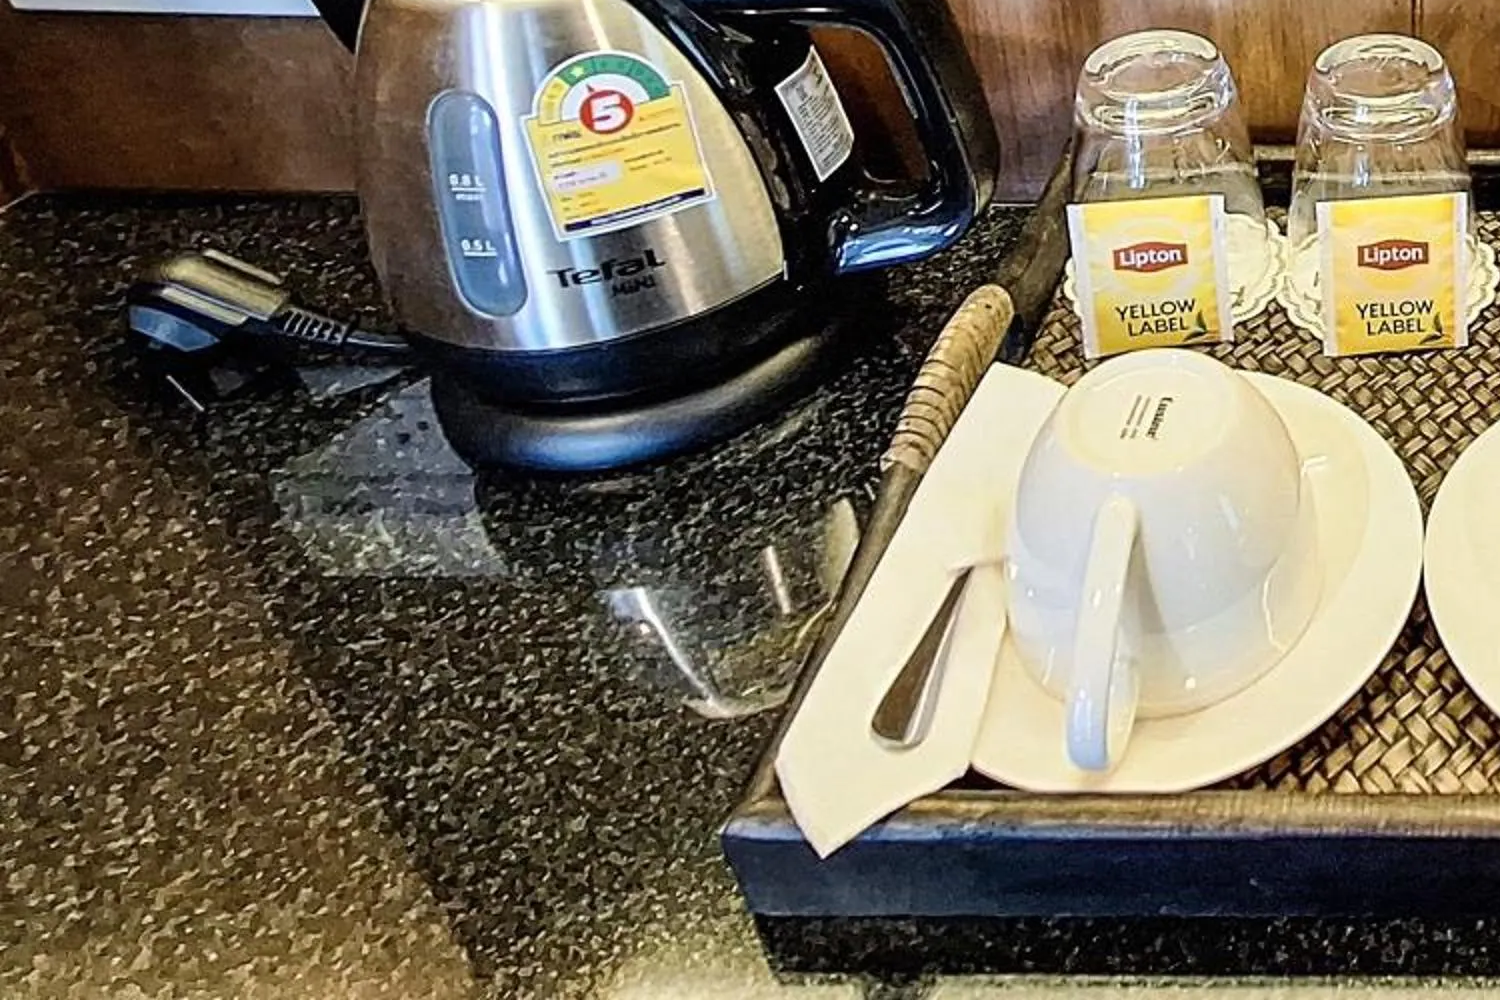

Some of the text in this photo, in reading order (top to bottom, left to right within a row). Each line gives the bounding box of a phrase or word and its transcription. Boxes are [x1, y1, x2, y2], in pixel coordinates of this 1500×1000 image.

[1119, 246, 1183, 269] Lipton
[1363, 244, 1424, 267] Lipton
[1115, 298, 1196, 322] YELLOW
[1355, 299, 1434, 321] YELLOW
[1127, 317, 1189, 338] LABEL
[1366, 318, 1426, 337] LABEL
